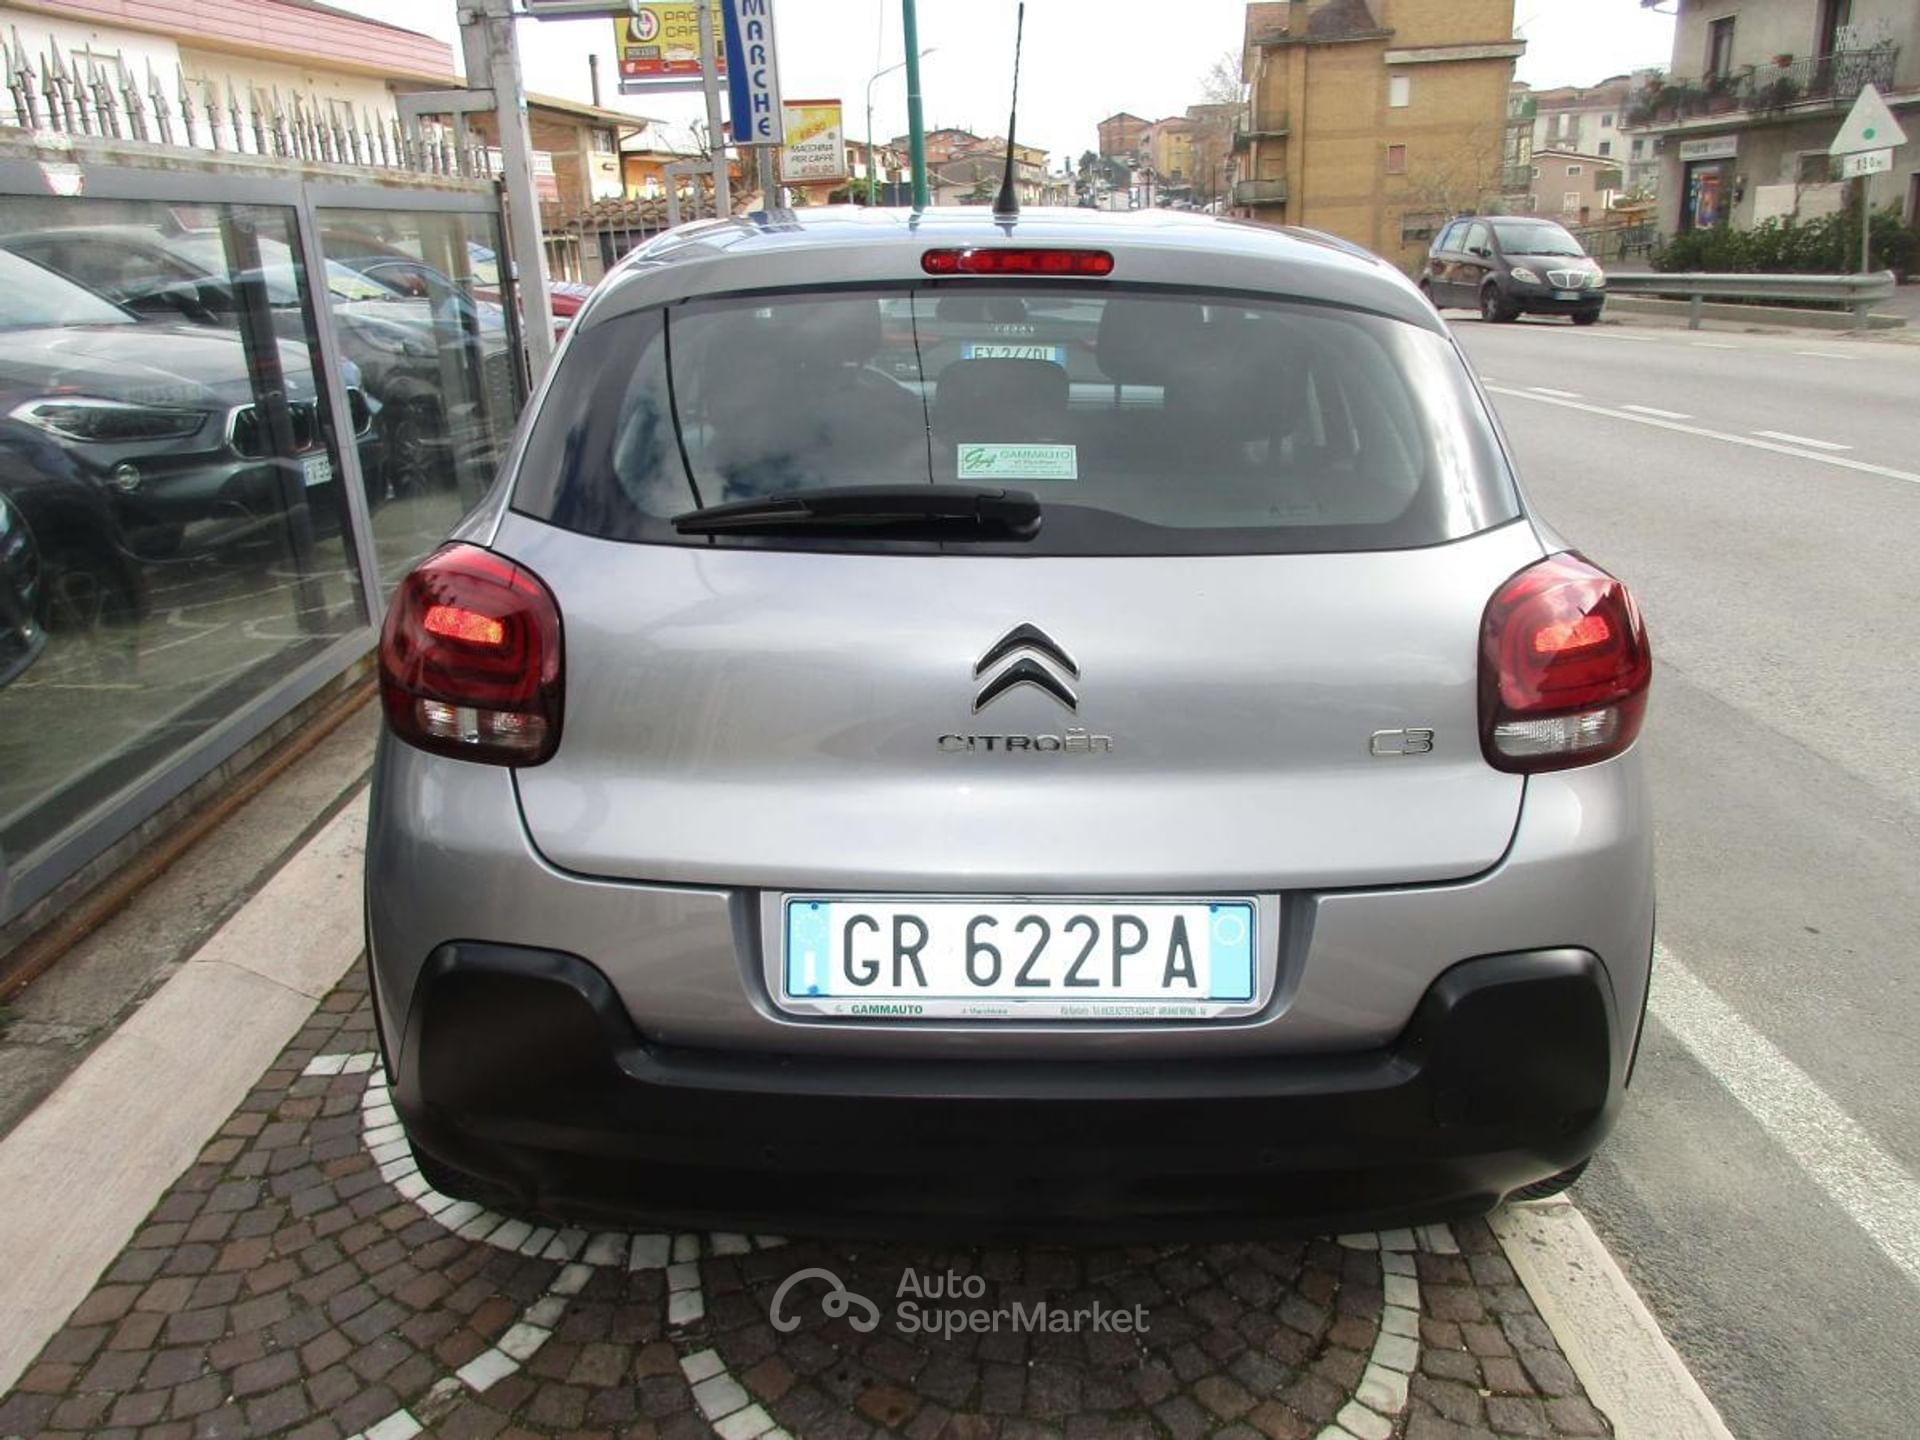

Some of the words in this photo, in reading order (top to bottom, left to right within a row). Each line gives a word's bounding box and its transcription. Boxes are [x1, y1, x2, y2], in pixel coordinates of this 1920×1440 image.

[665, 25, 721, 38] CAFE
[937, 727, 1113, 753] CITROËN
[1369, 727, 1435, 757] C3
[842, 913, 929, 988] GR
[964, 913, 1199, 988] 622PA
[850, 1003, 924, 1016] GAMMAUTO
